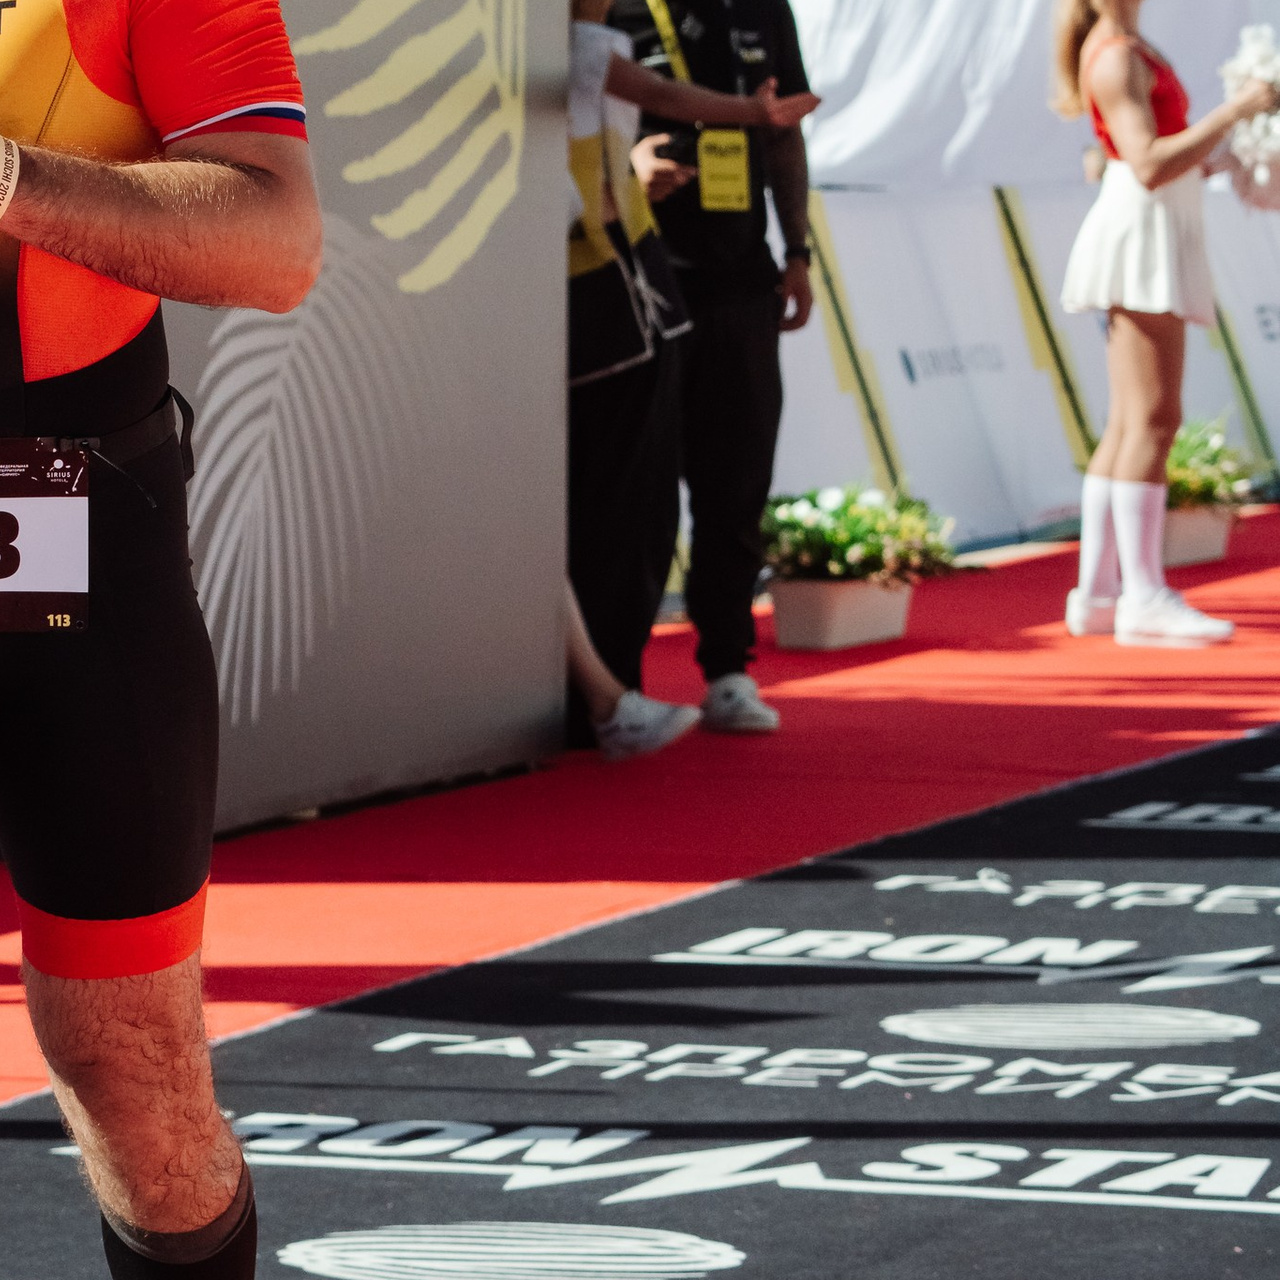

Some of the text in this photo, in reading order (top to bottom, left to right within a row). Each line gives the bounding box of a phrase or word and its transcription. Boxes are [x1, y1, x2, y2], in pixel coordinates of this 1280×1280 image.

[2, 158, 15, 183] SOCHI
[46, 471, 71, 479] SIRIUS
[47, 614, 71, 627] 113
[688, 927, 1139, 965] IRON
[230, 1111, 1280, 1199] RON STA
